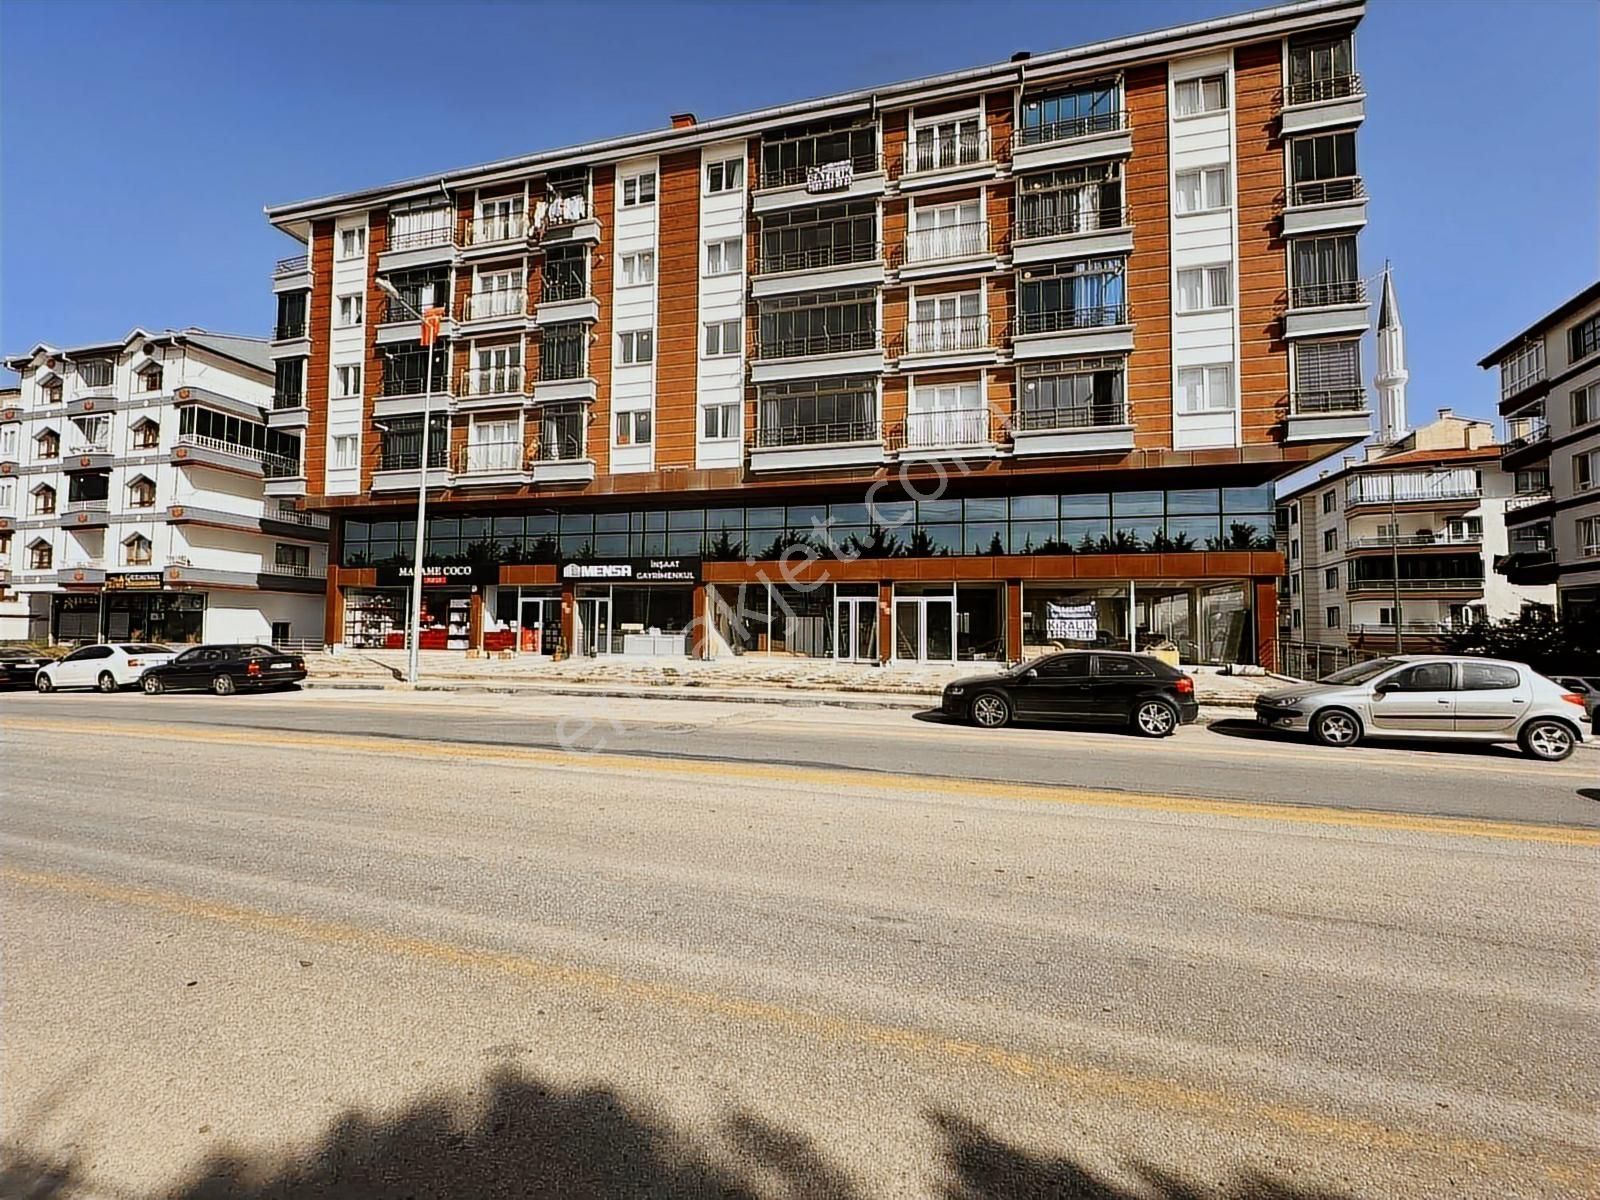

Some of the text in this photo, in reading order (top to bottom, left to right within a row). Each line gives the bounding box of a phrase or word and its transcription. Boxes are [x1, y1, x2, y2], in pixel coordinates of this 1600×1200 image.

[398, 566, 472, 576] MAAME COCO
[581, 565, 632, 577] MENSA
